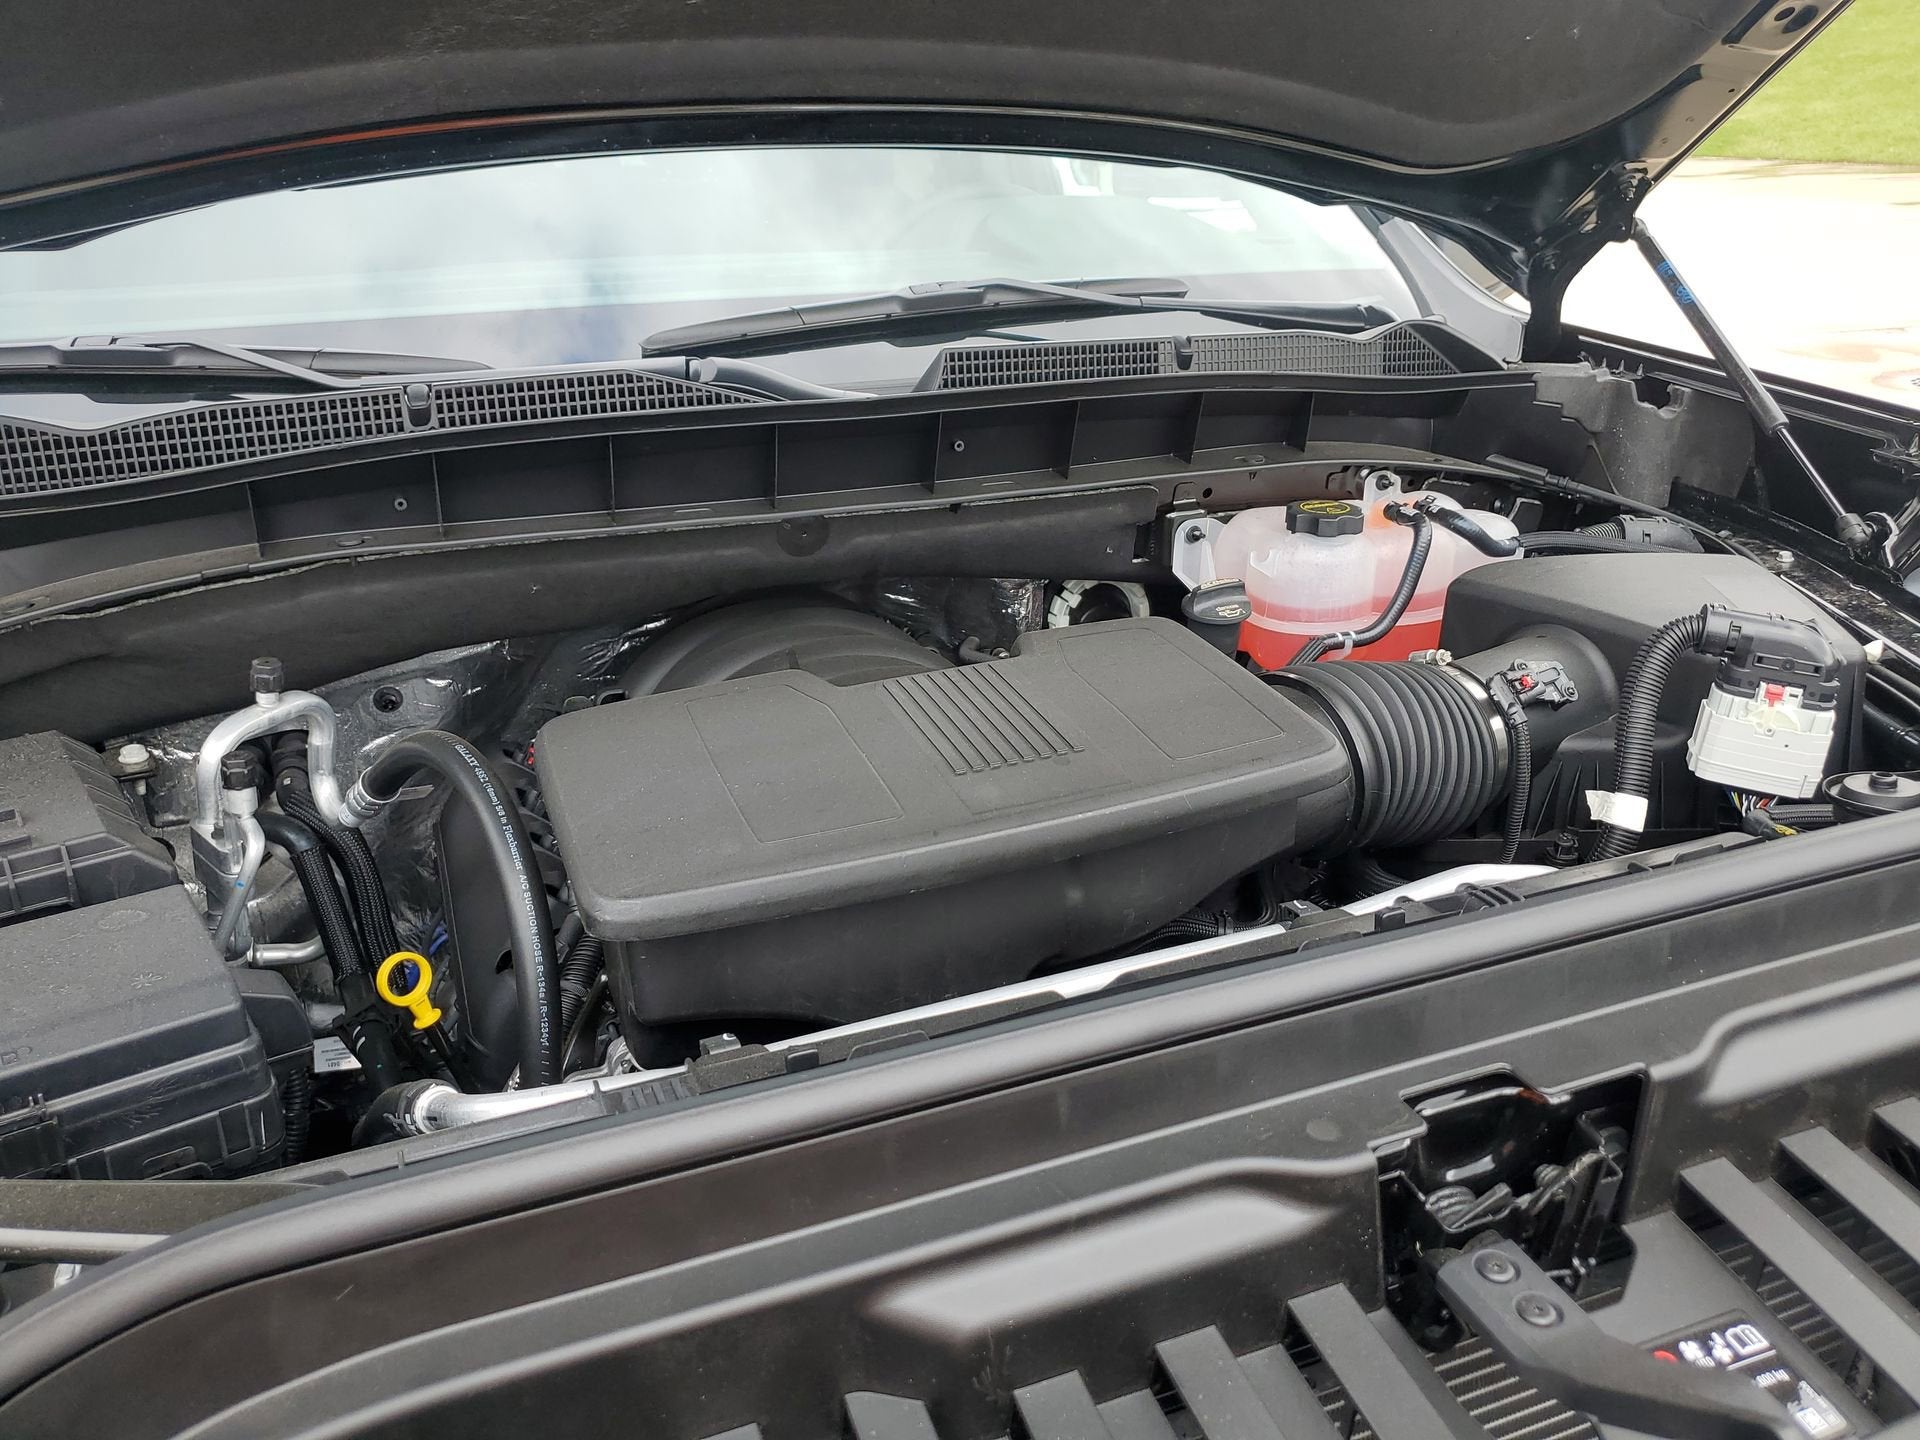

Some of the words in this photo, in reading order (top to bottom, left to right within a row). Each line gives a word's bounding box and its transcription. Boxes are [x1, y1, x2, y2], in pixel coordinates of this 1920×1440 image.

[455, 744, 480, 767] GALAXY
[482, 782, 500, 806] (16mm)
[495, 805, 506, 816] 5/8
[500, 816, 508, 824] in
[502, 824, 523, 871] Flexbarrier
[519, 874, 530, 890] A/C
[523, 891, 538, 934] SUCTION
[531, 935, 543, 963] HOSE
[536, 965, 546, 998] R-134a
[540, 1005, 550, 1047] R-1234yf
